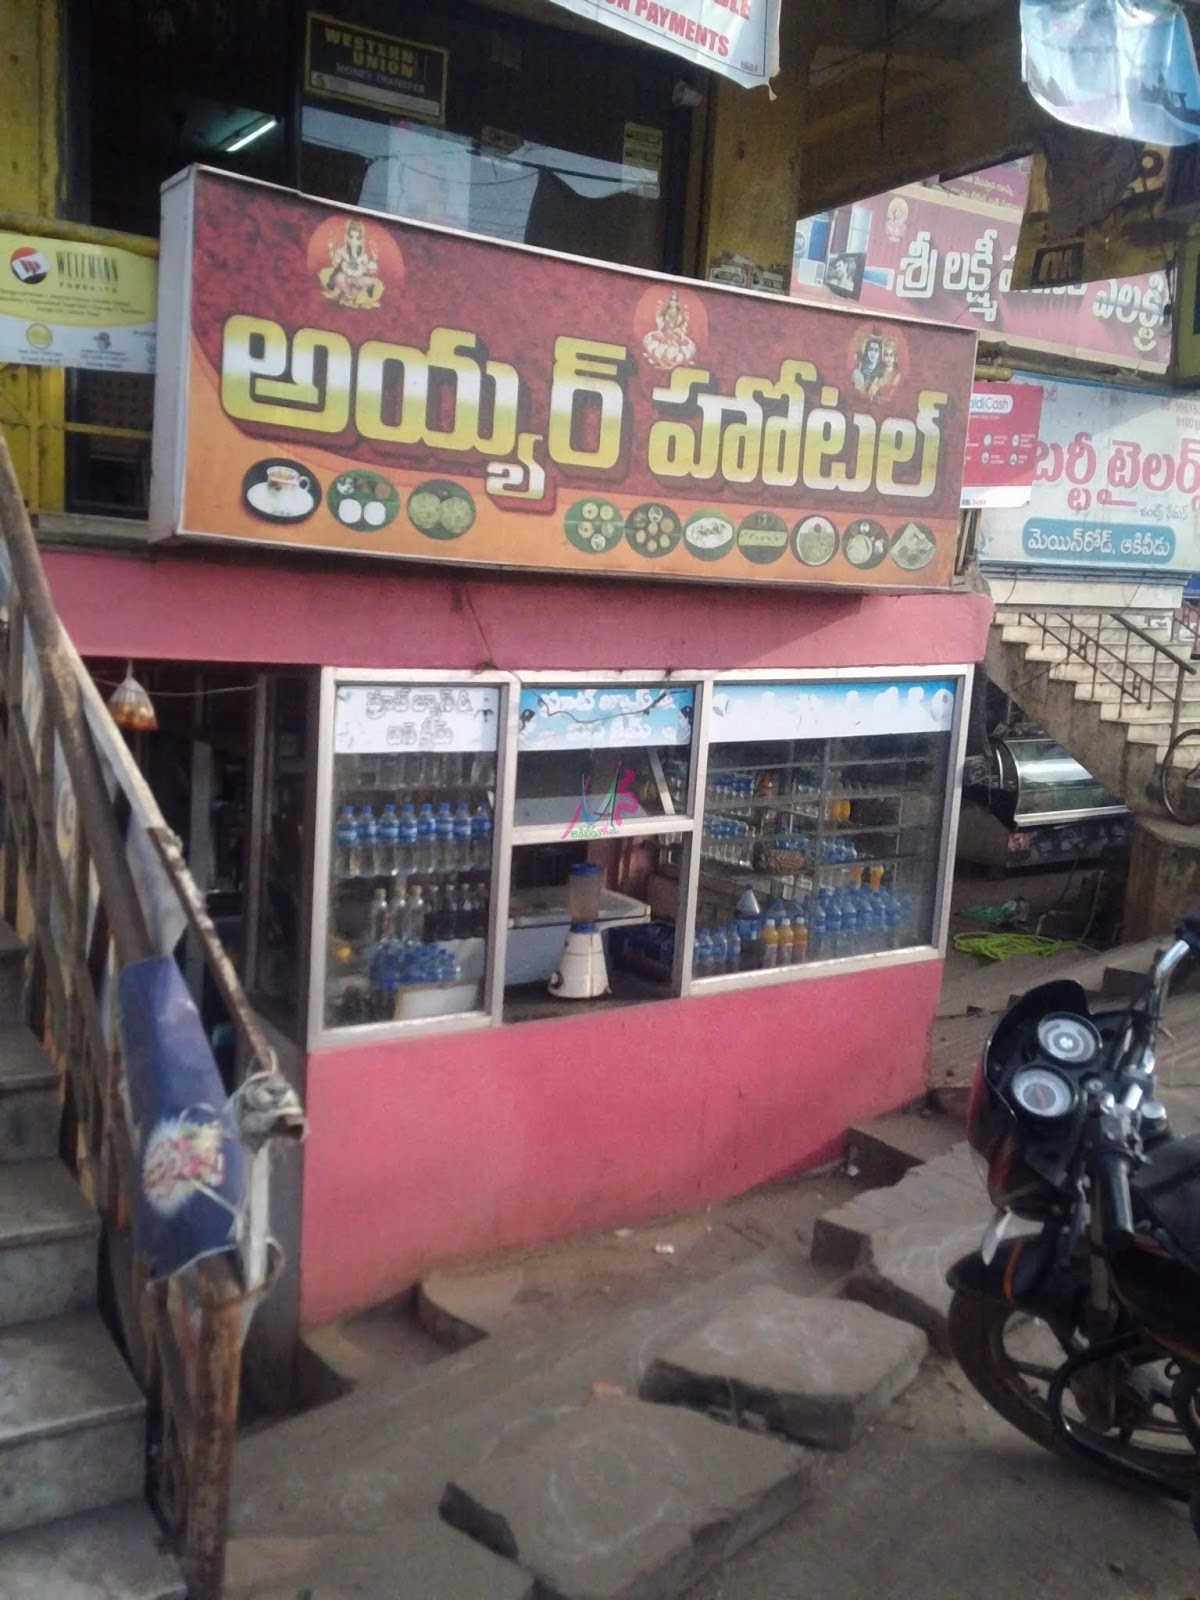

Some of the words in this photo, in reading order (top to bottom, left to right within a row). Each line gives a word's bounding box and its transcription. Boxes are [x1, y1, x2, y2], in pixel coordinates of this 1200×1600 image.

[324, 26, 414, 64] WESTERN
[352, 49, 414, 78] UNION
[635, 0, 730, 57] PAYMENTS
[896, 231, 938, 298] శ్రీ
[943, 229, 998, 322] లక్ష్మీ
[1092, 274, 1170, 350] ఎలక్ట్రి
[221, 314, 628, 500] అయ్యర్
[648, 359, 949, 498] హోటల్
[1096, 439, 1200, 512] టైలర్
